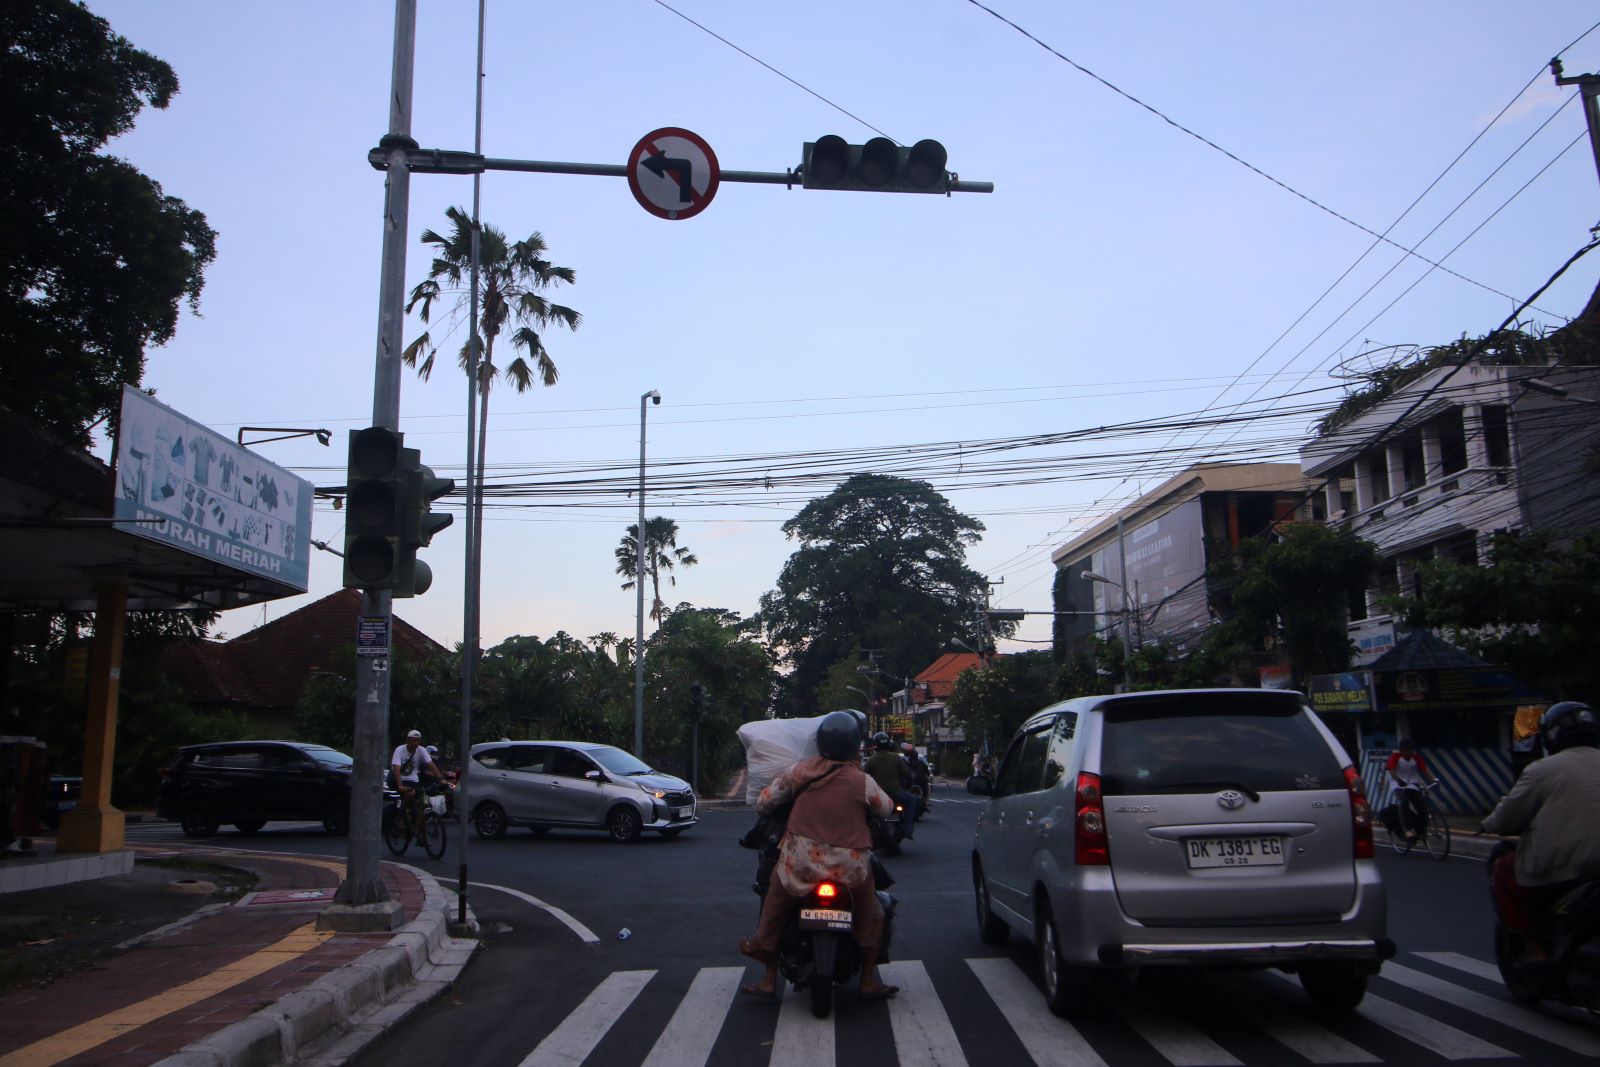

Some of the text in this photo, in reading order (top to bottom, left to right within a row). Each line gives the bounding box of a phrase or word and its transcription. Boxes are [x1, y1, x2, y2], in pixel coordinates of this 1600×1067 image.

[136, 510, 281, 573] MURAH MERIAH
[1190, 838, 1280, 858] DK 1381 EG
